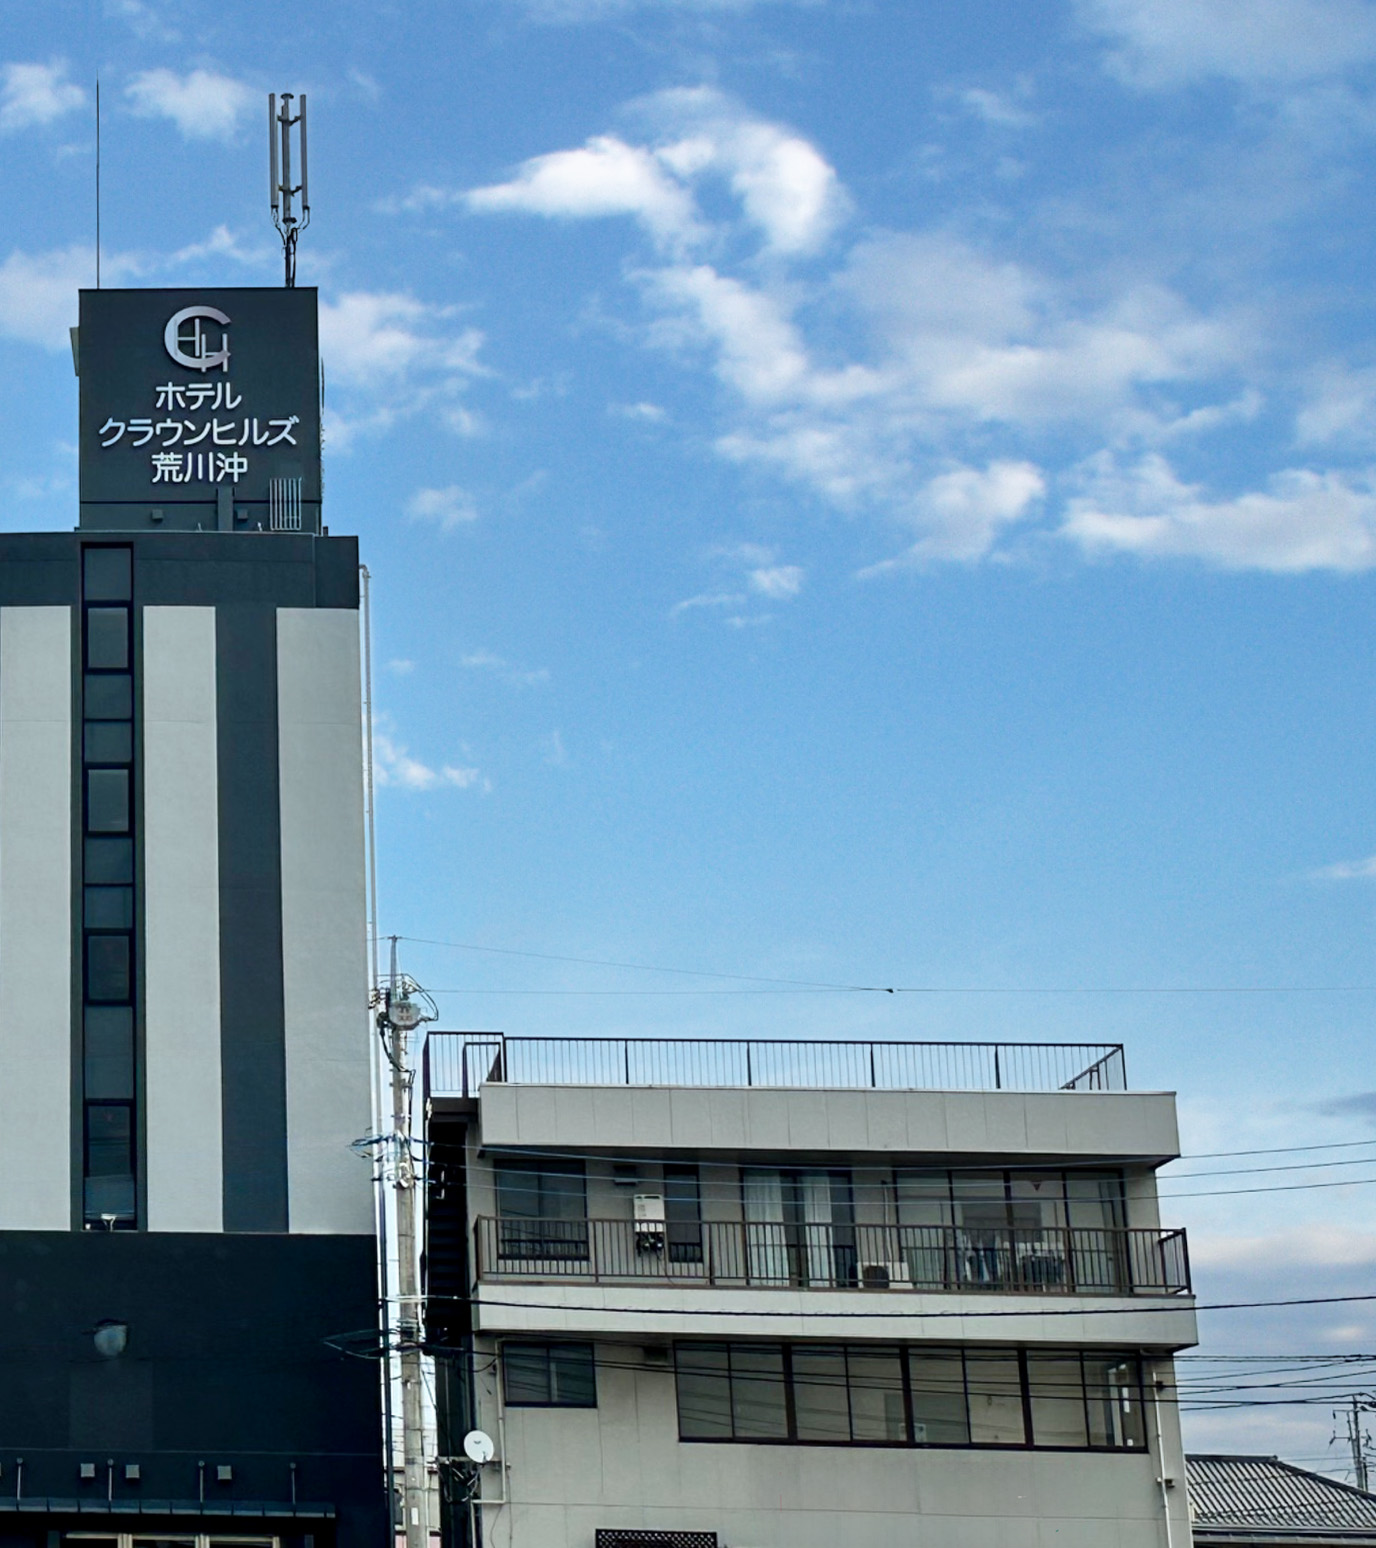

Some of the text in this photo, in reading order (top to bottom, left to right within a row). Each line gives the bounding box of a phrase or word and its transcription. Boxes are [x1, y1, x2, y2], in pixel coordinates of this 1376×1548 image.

[155, 382, 241, 410] ホテル
[99, 416, 299, 446] クラウンヒルズ
[151, 452, 248, 483] 荒川沖
